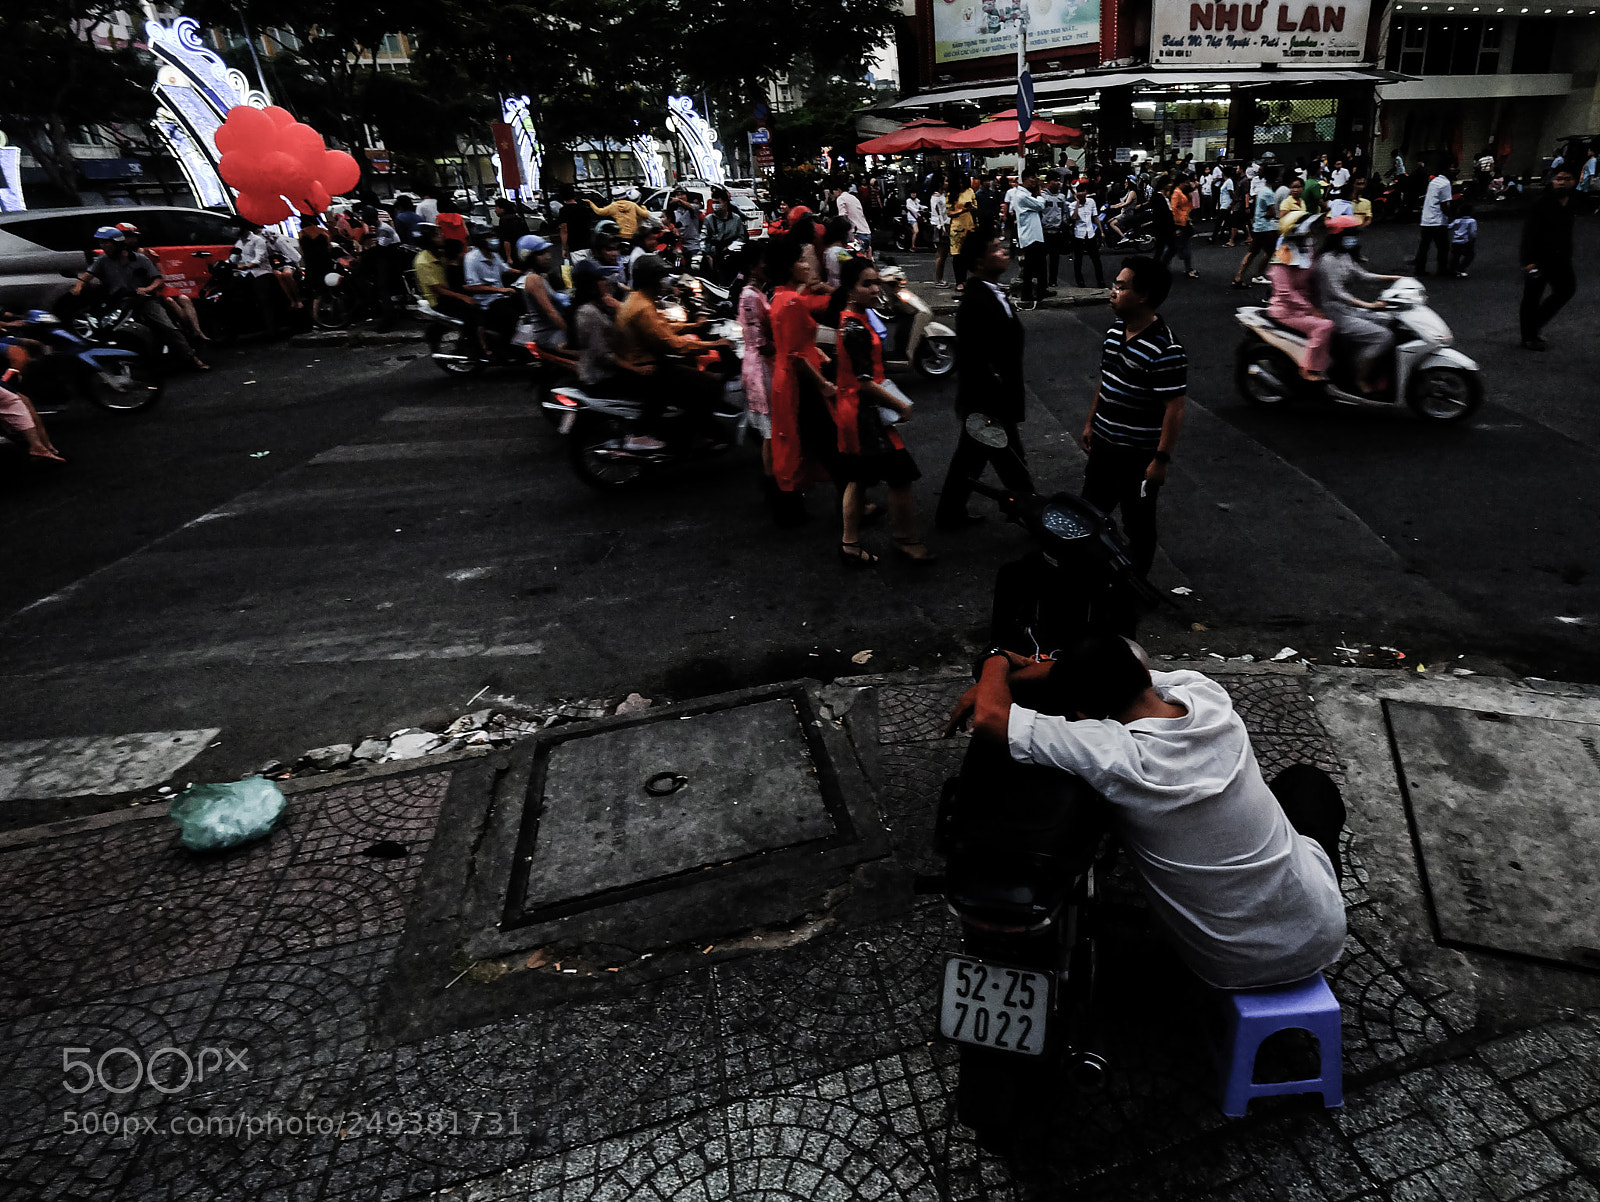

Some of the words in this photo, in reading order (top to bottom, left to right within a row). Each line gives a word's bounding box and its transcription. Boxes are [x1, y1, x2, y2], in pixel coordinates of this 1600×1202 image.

[1189, 0, 1269, 32] NHƯ
[1277, 5, 1346, 33] LAN
[1162, 35, 1185, 47] Bánh
[953, 1002, 1033, 1051] 7022
